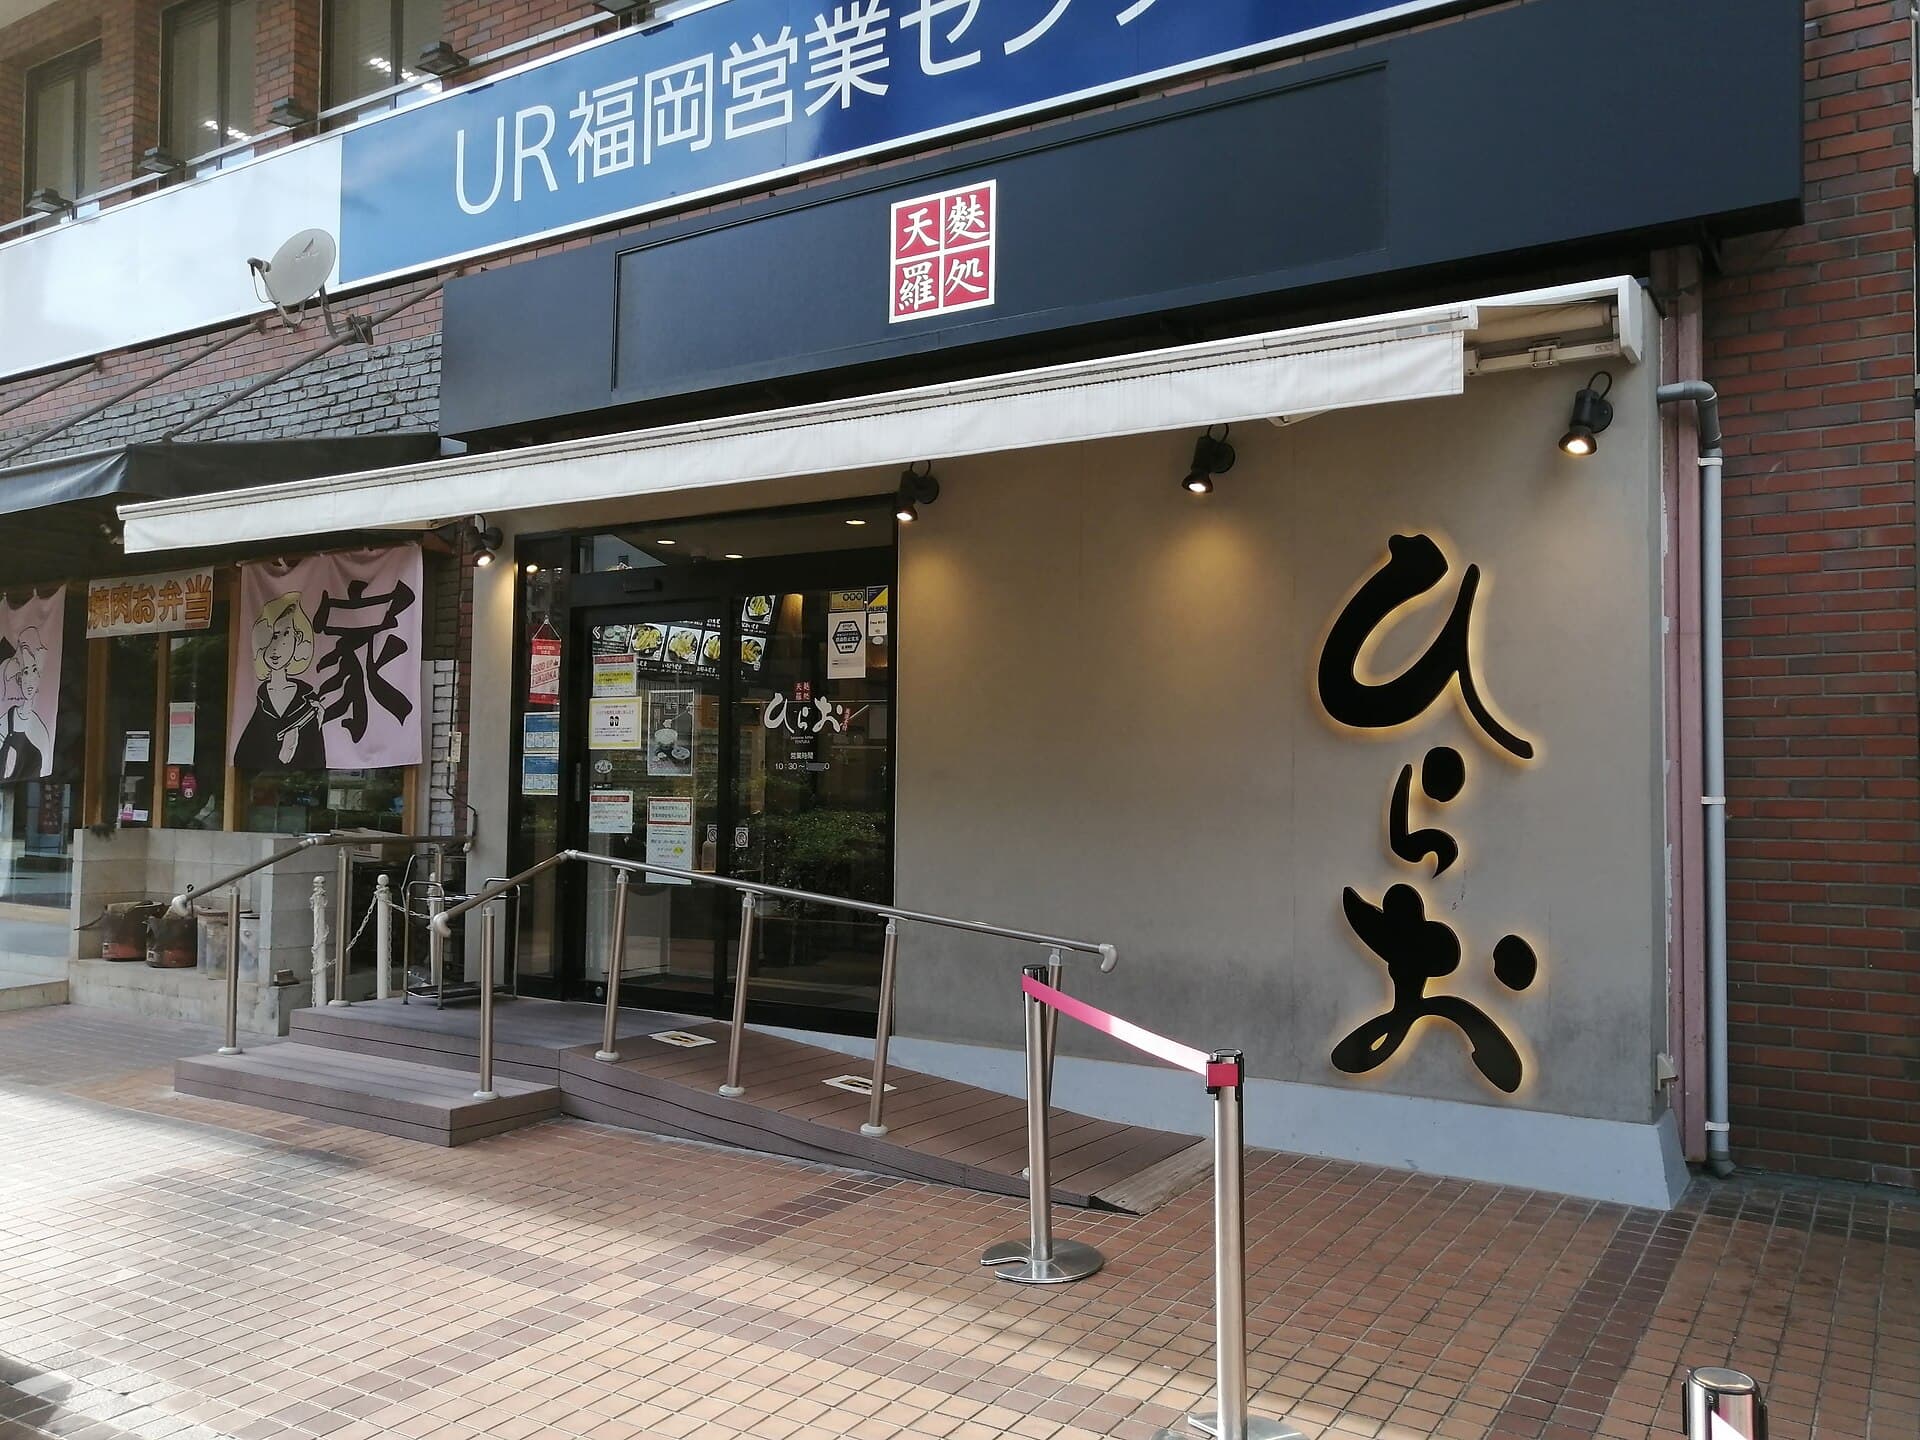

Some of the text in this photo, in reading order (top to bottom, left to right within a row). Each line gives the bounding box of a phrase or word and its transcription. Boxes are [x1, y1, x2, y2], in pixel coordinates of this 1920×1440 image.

[87, 574, 212, 630] 焼肉お弁当
[312, 579, 416, 744] 家
[764, 692, 843, 733] ひらお
[1317, 533, 1538, 1095] ひらお
